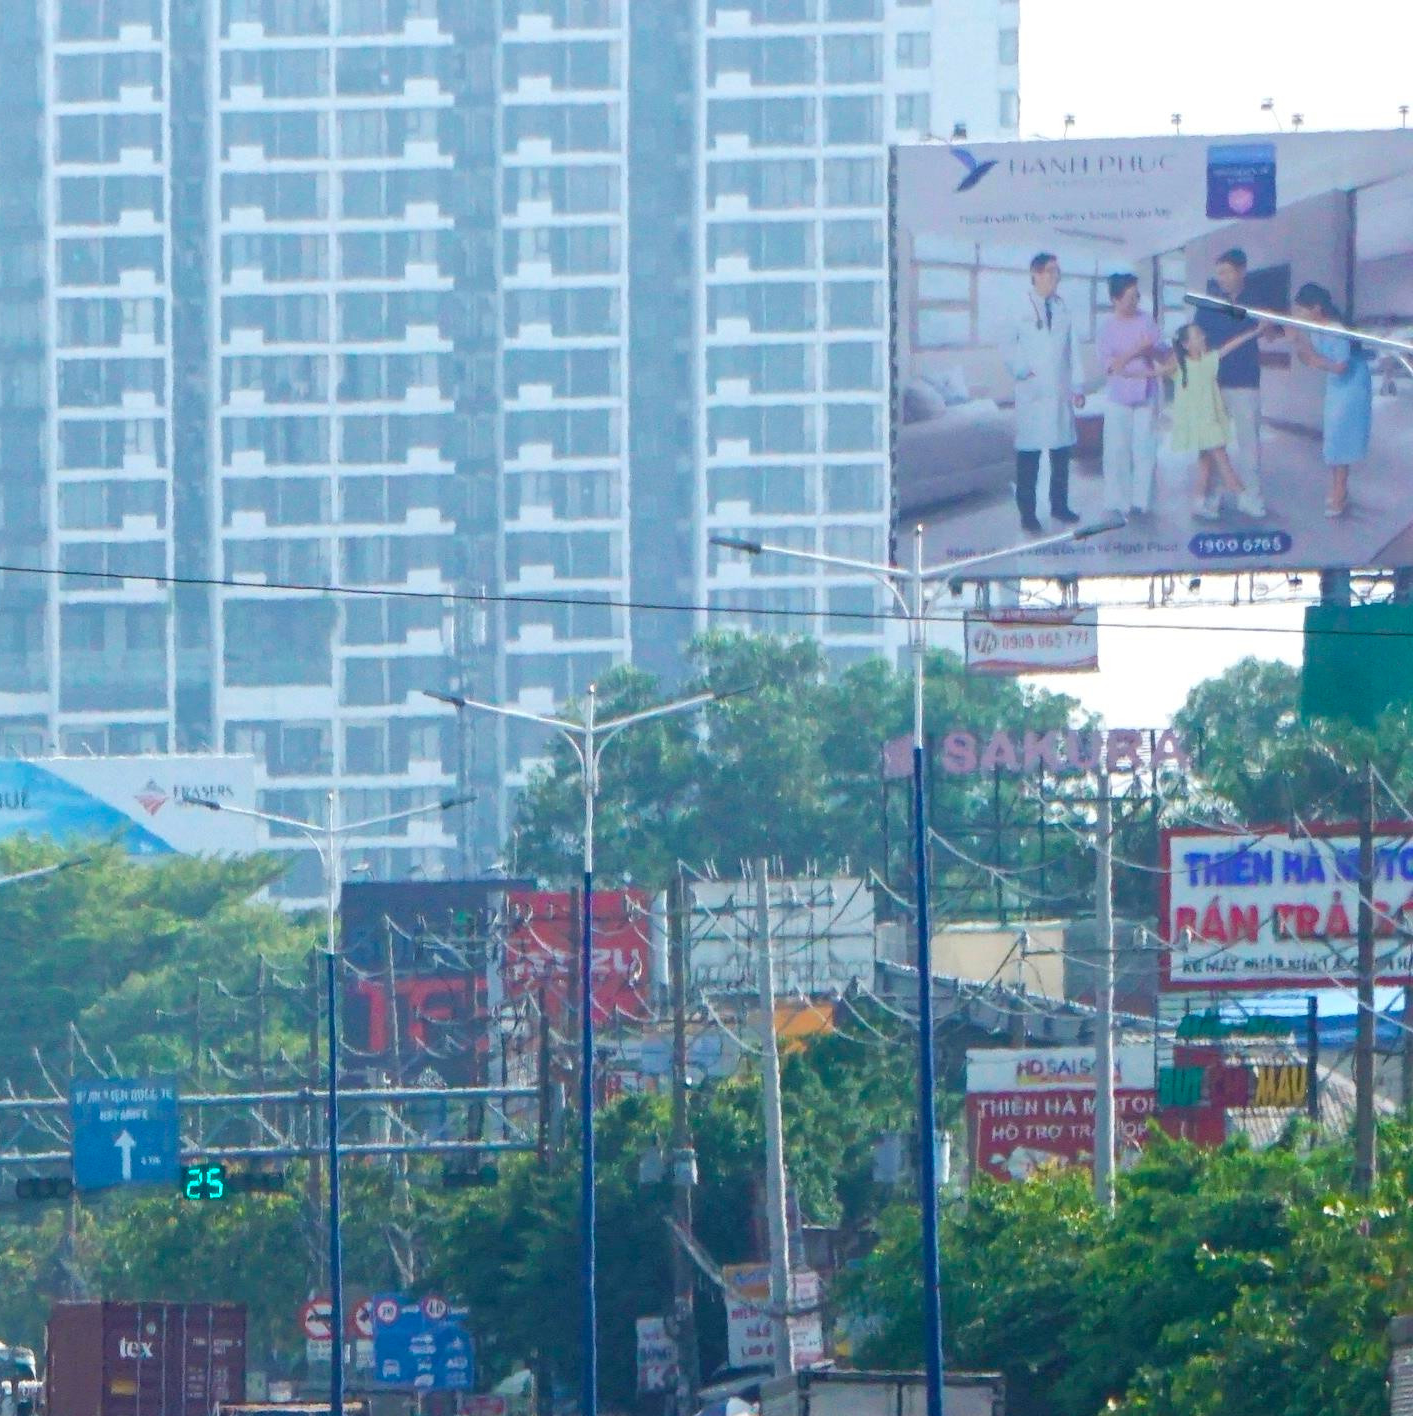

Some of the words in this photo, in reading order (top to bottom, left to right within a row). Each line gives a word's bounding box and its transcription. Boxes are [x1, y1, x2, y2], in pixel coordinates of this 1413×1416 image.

[941, 728, 1193, 775] SAKURA
[979, 1095, 1039, 1118] THIÊN
[186, 1167, 224, 1200] 25
